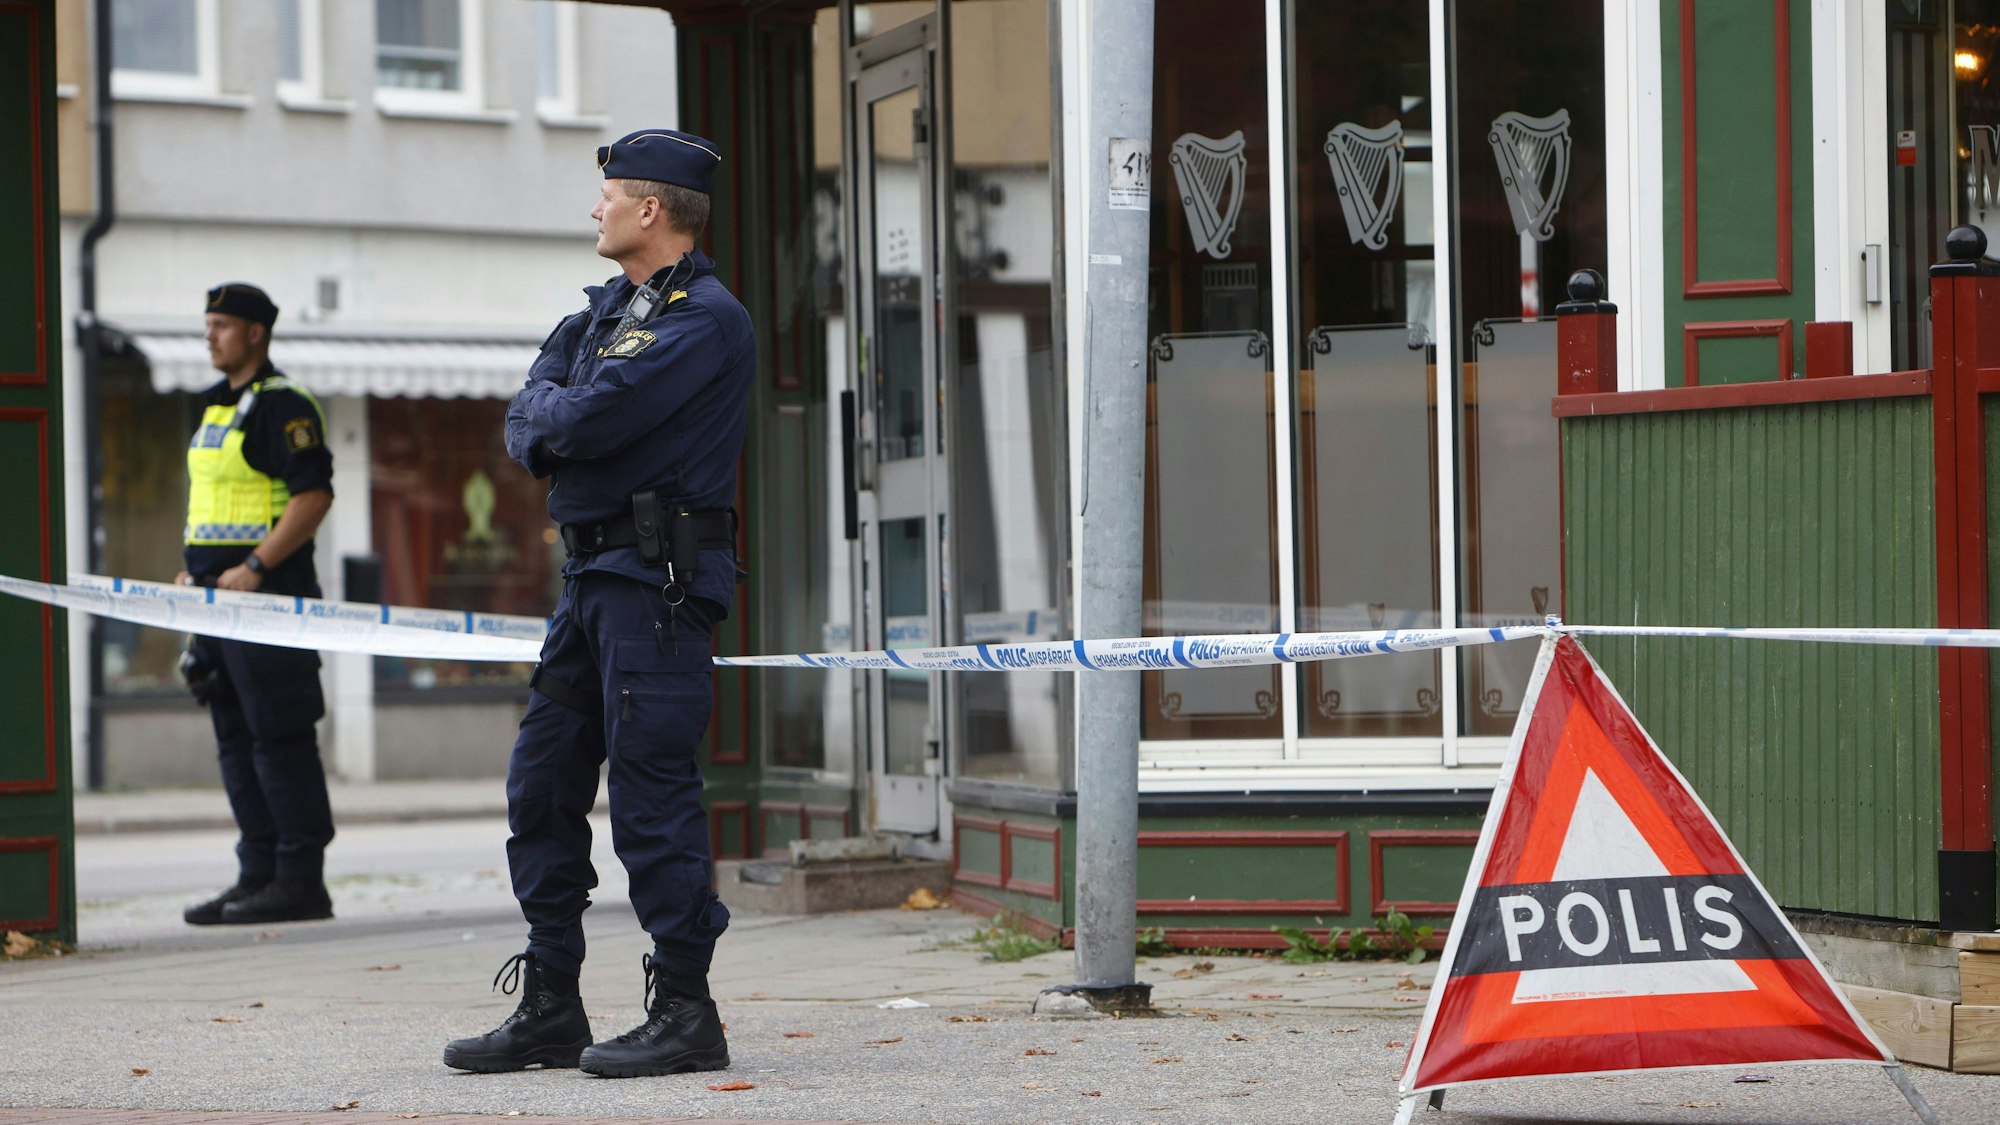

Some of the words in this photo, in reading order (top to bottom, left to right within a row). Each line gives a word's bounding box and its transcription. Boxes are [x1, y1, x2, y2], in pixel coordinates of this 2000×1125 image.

[996, 648, 1031, 668] POLIS
[1028, 648, 1074, 665] AVSPÄRRAT
[1138, 648, 1175, 668] POLIS
[1188, 639, 1222, 660] POLIS
[1498, 885, 1743, 962] POLIS
